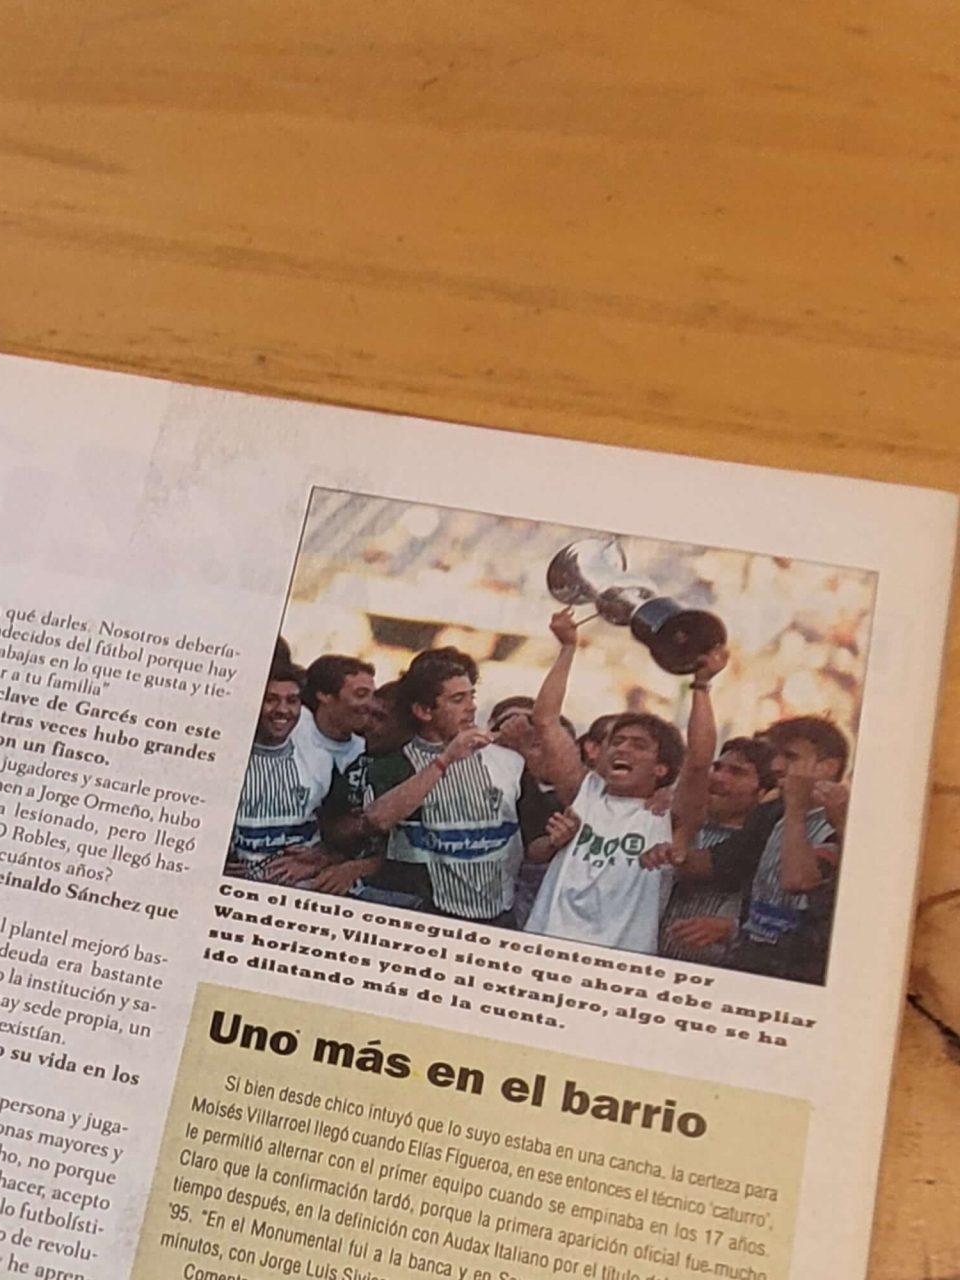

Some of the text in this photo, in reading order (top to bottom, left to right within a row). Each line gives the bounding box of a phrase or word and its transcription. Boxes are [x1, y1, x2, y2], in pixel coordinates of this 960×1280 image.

[22, 739, 47, 755] un
[50, 739, 111, 767] fiasco.
[39, 719, 88, 739] veces
[92, 724, 140, 749] hubo
[142, 739, 217, 763] grandes
[45, 693, 69, 713] de
[74, 699, 139, 726] Garcés
[143, 716, 178, 734] con
[183, 724, 222, 741] este
[213, 903, 818, 1029] Wanderers, Villarroel siente que ahora debe ampliar
[217, 883, 716, 988] Con el título conseguido recientemente por
[202, 946, 566, 1030] ido dilatando más de la cuenta.
[207, 928, 788, 1048] sus horizontes yendo al extranjero, algo que se ha
[208, 1009, 708, 1139] Uno más en el barrio
